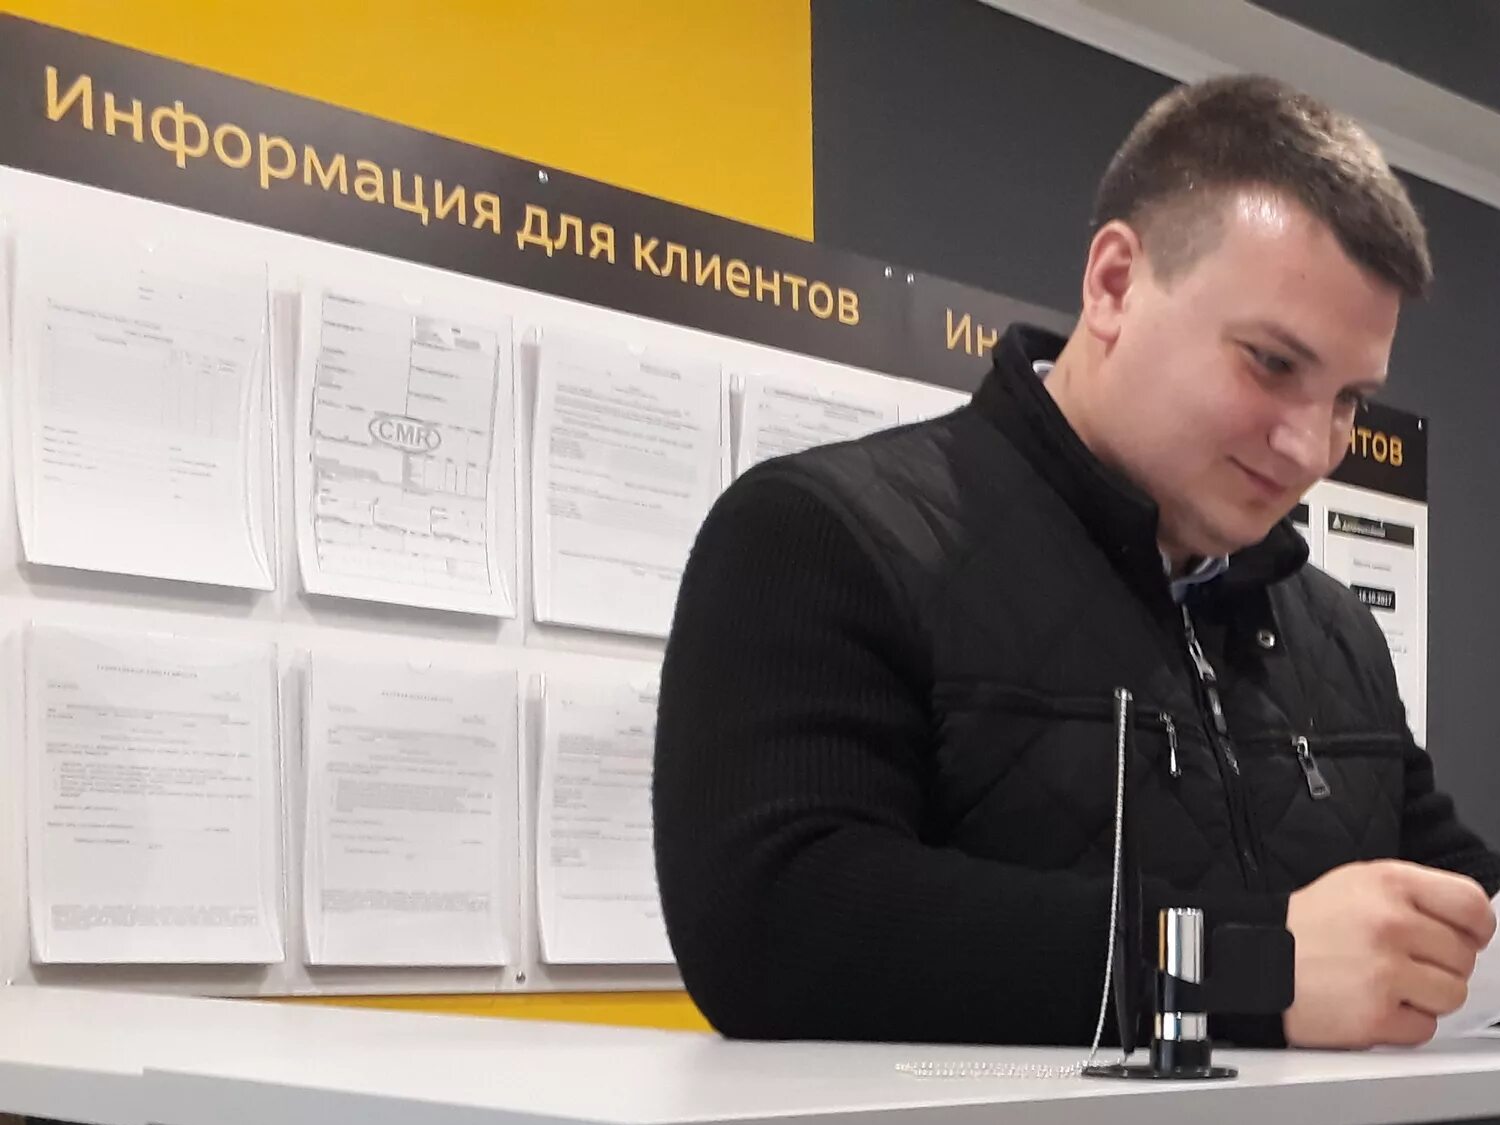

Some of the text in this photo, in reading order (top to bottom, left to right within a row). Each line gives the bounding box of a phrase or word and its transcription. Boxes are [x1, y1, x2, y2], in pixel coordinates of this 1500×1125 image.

[45, 65, 861, 327] Информация для клиентов
